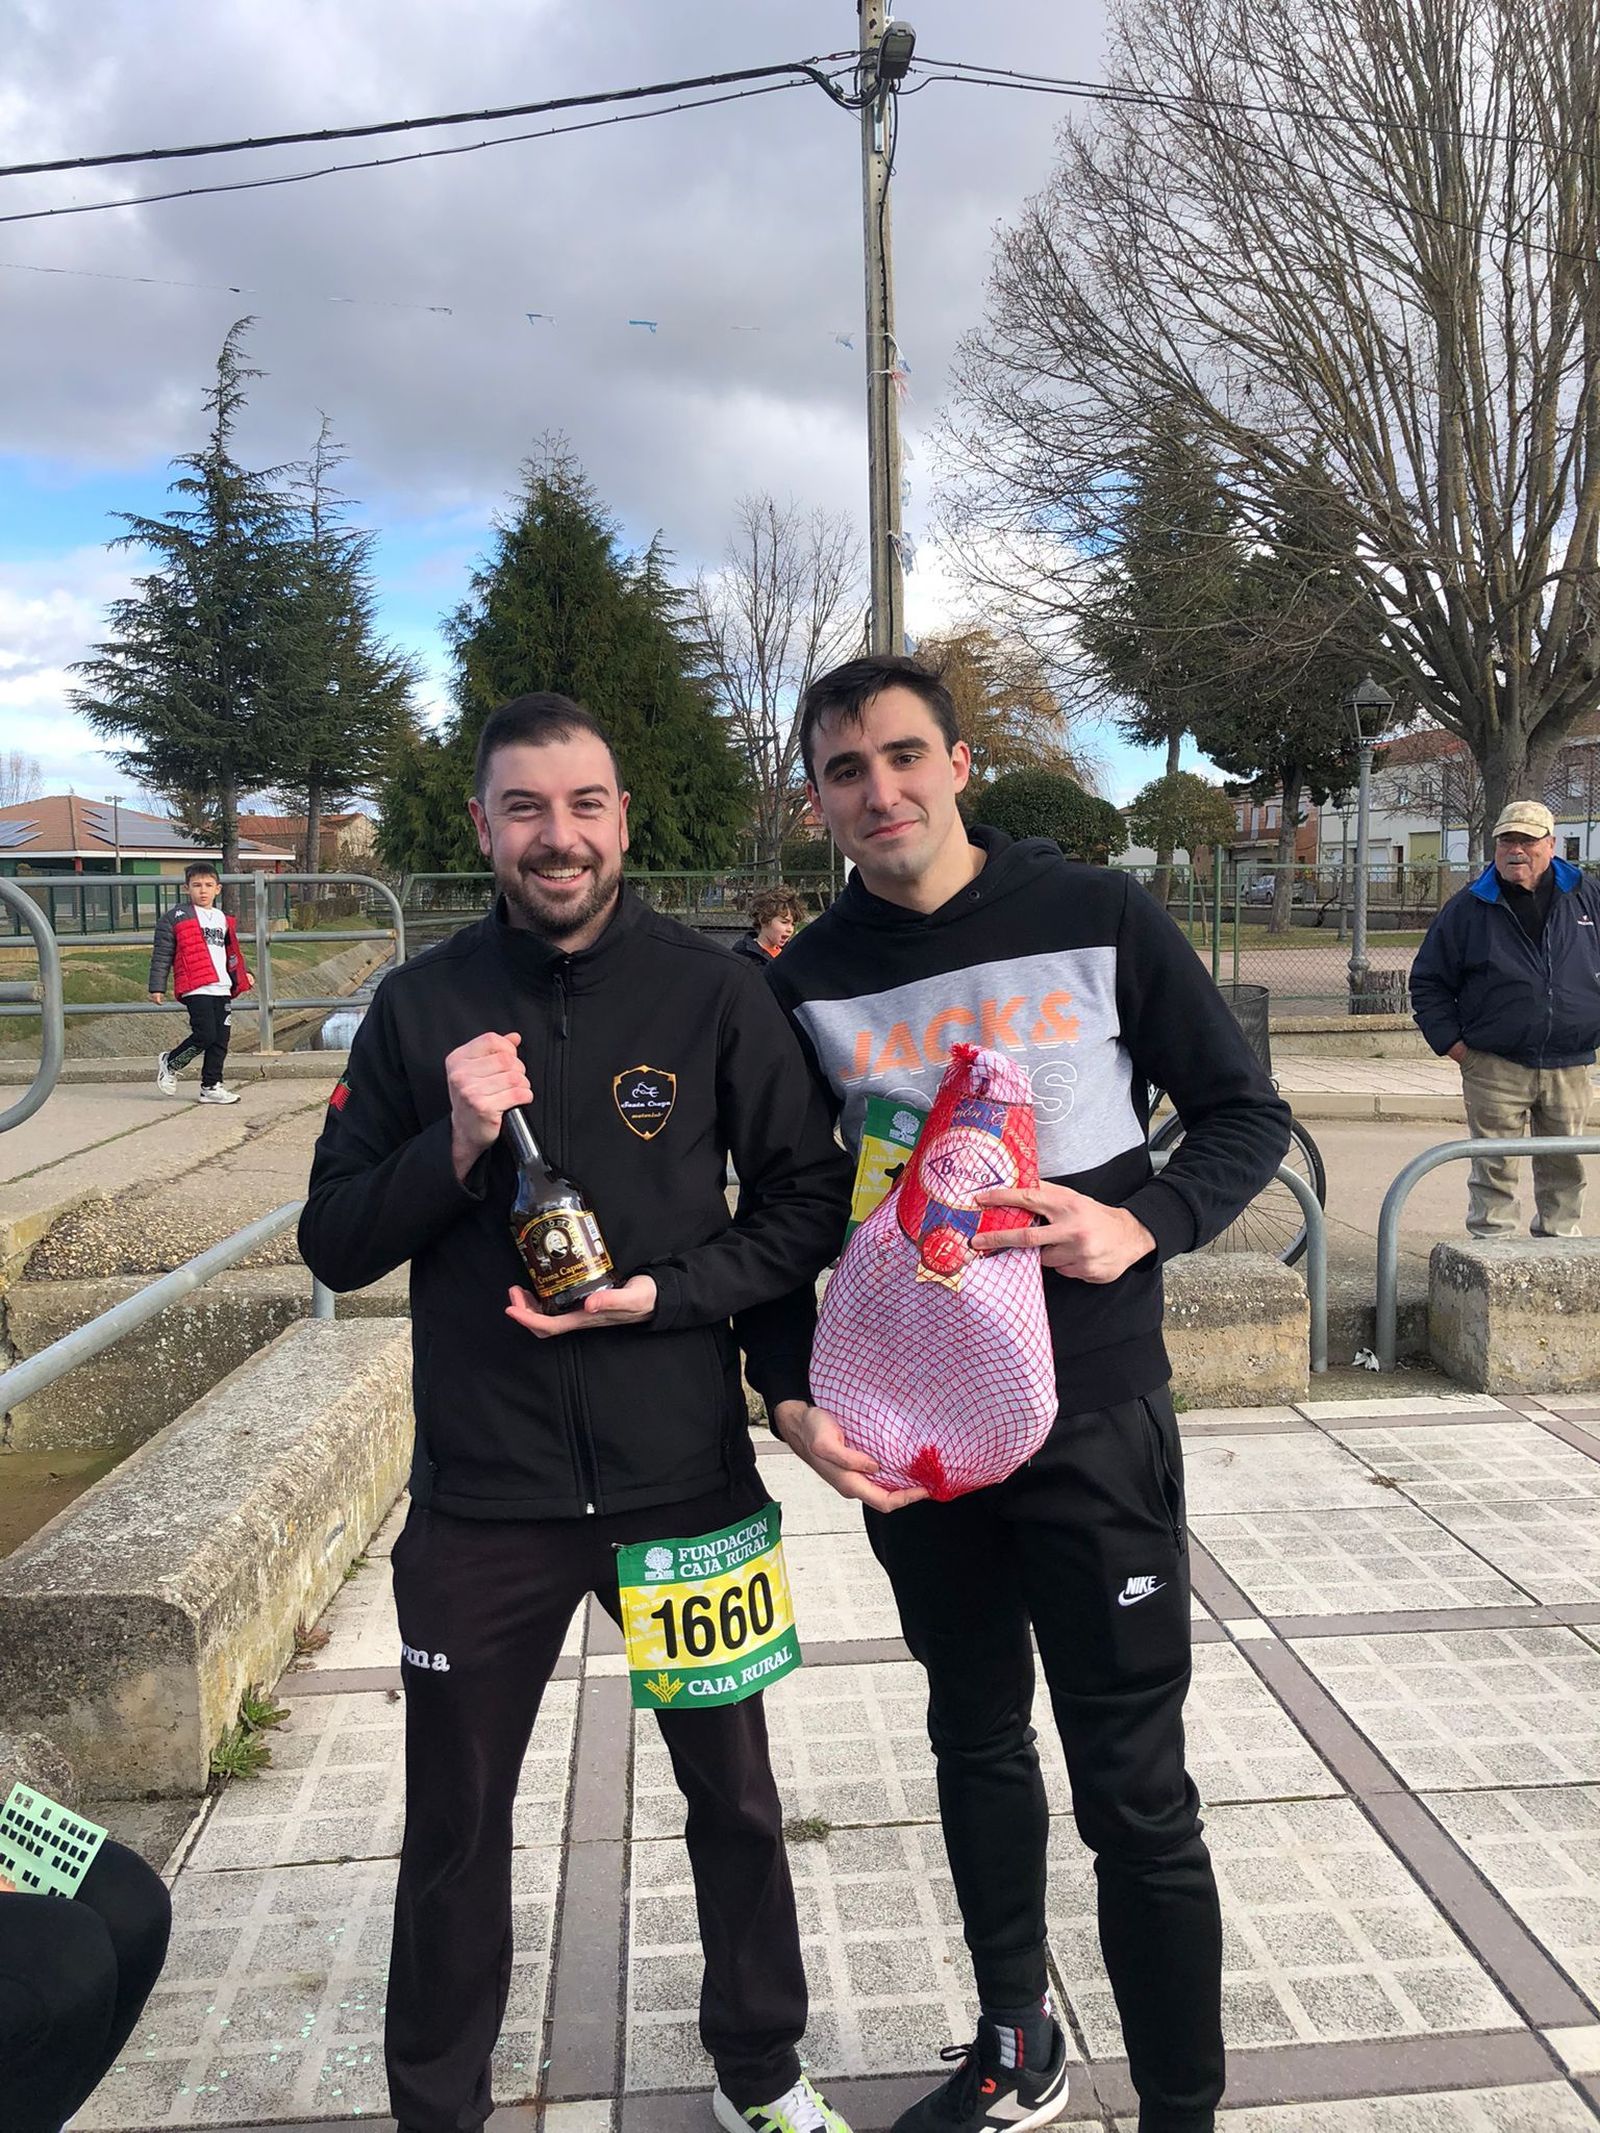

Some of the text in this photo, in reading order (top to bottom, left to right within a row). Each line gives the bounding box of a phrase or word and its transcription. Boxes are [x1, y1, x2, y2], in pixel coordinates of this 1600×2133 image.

[677, 1517, 768, 1562] FUNDACION
[679, 1535, 770, 1578] CAJA RURAL
[1125, 1575, 1157, 1595] NIKE
[651, 1572, 774, 1659] 1660
[403, 1644, 451, 1672] ma
[687, 1645, 793, 1696] CAJA RURAL
